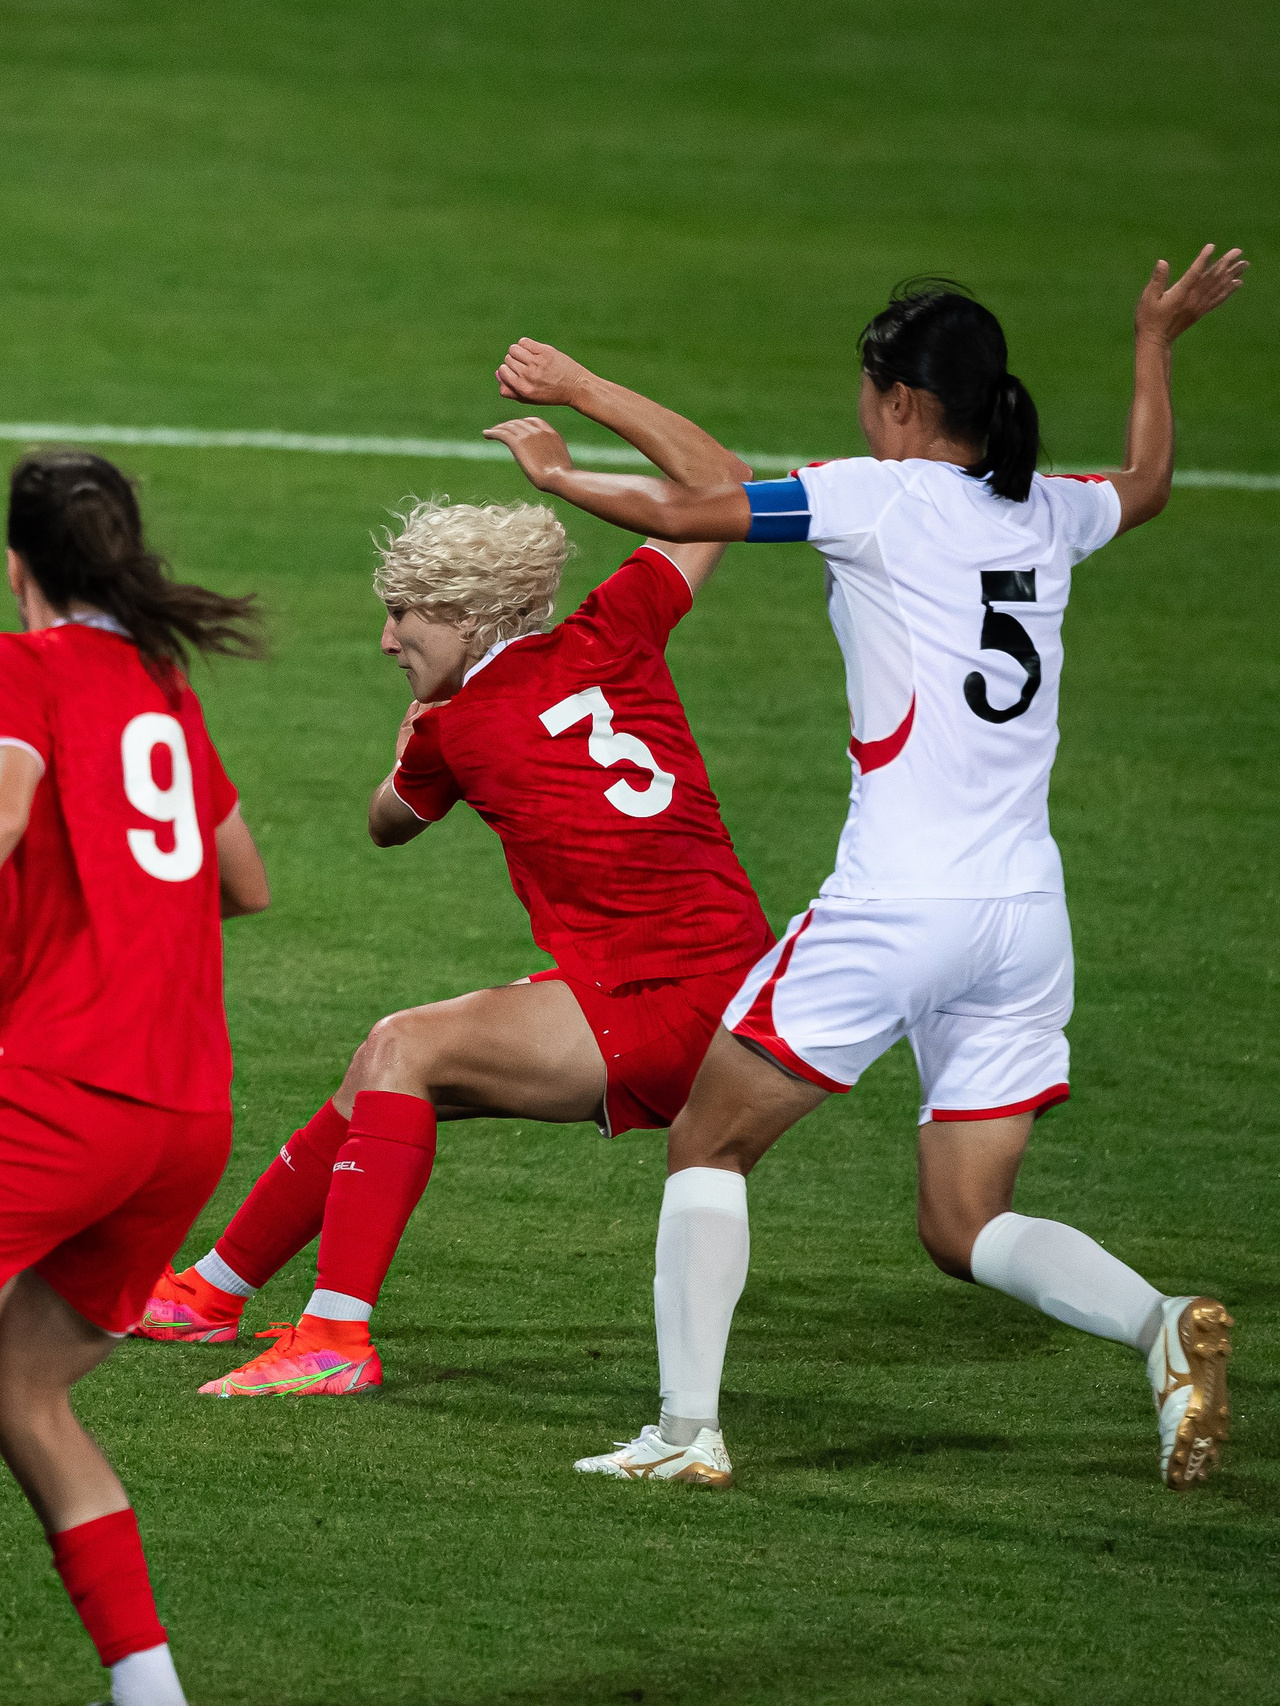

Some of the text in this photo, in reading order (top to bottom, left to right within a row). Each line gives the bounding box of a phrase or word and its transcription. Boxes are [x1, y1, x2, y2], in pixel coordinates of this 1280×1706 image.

[964, 568, 1042, 724] 5
[121, 712, 204, 882] 9
[538, 686, 676, 818] 3
